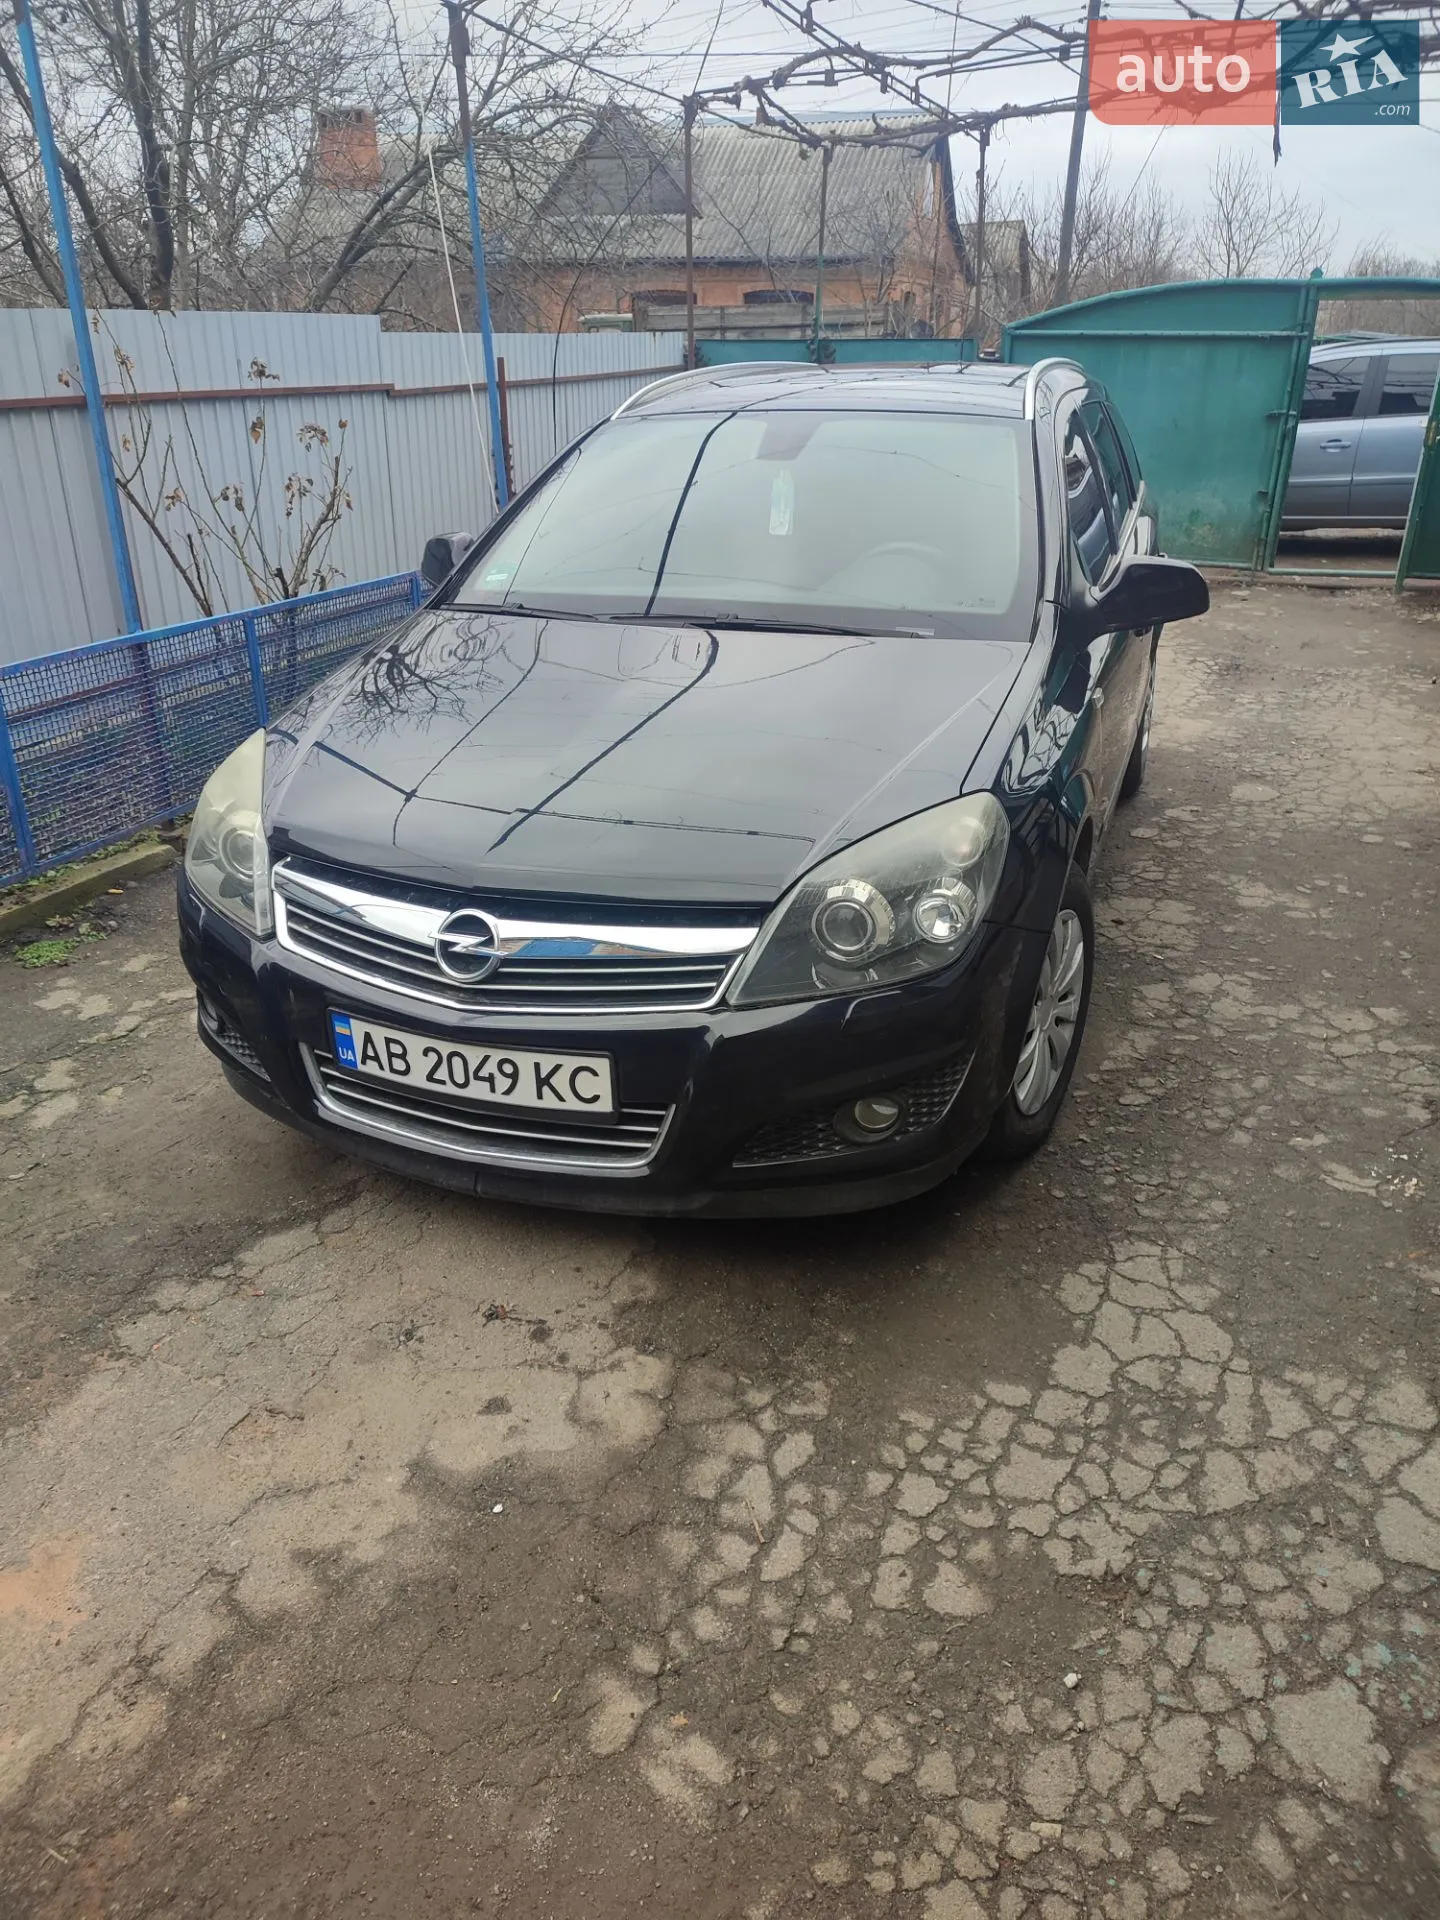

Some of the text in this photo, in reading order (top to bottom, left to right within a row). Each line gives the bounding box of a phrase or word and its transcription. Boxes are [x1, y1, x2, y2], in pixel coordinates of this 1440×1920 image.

[338, 1046, 355, 1062] UA
[360, 1031, 601, 1104] AB 2049 KC
